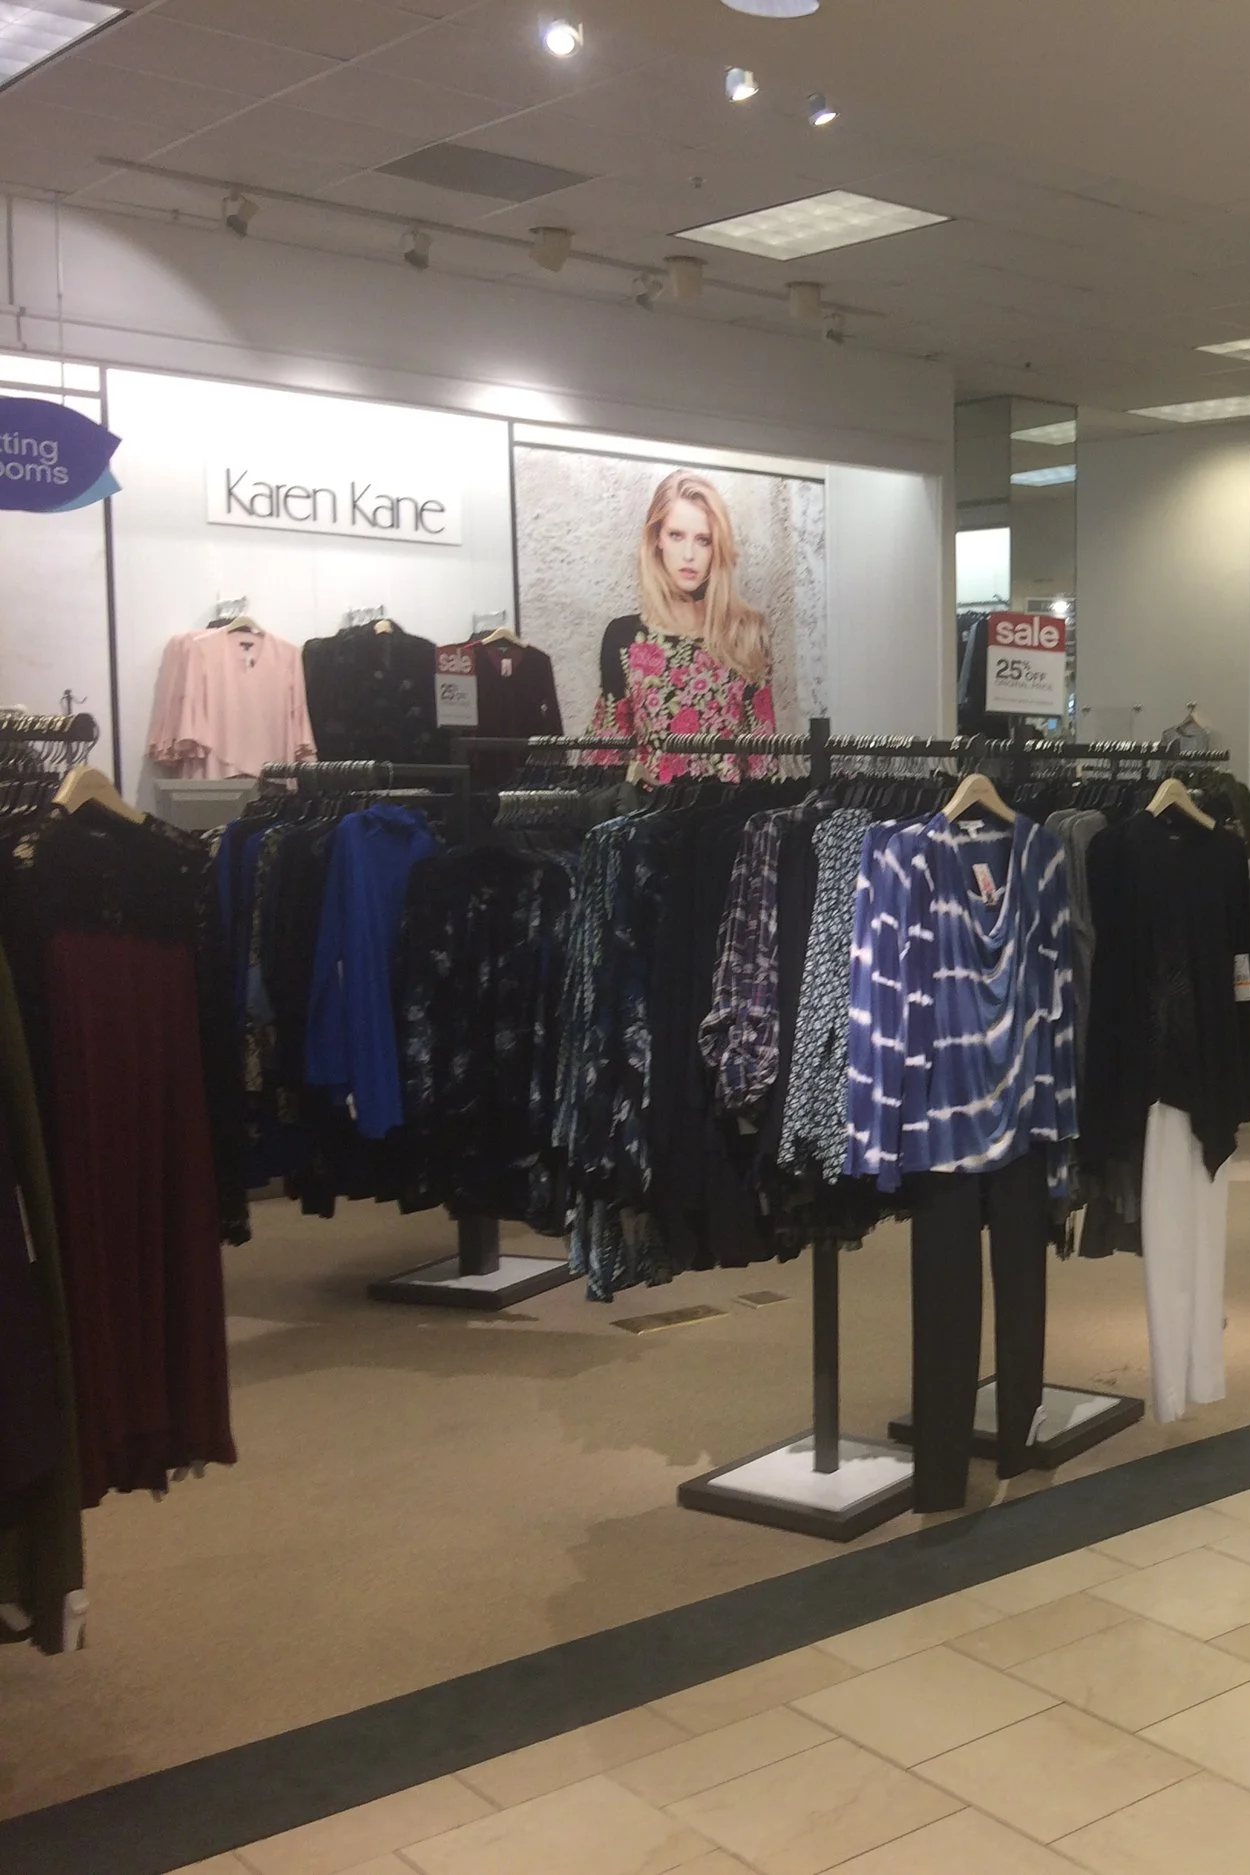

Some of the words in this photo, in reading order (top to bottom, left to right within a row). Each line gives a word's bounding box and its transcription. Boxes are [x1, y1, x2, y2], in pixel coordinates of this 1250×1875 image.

[0, 431, 58, 465] ting
[225, 467, 337, 524] Karen
[350, 481, 446, 535] Kane
[995, 615, 1060, 649] sale
[438, 647, 472, 674] sale
[1025, 671, 1048, 682] OFF
